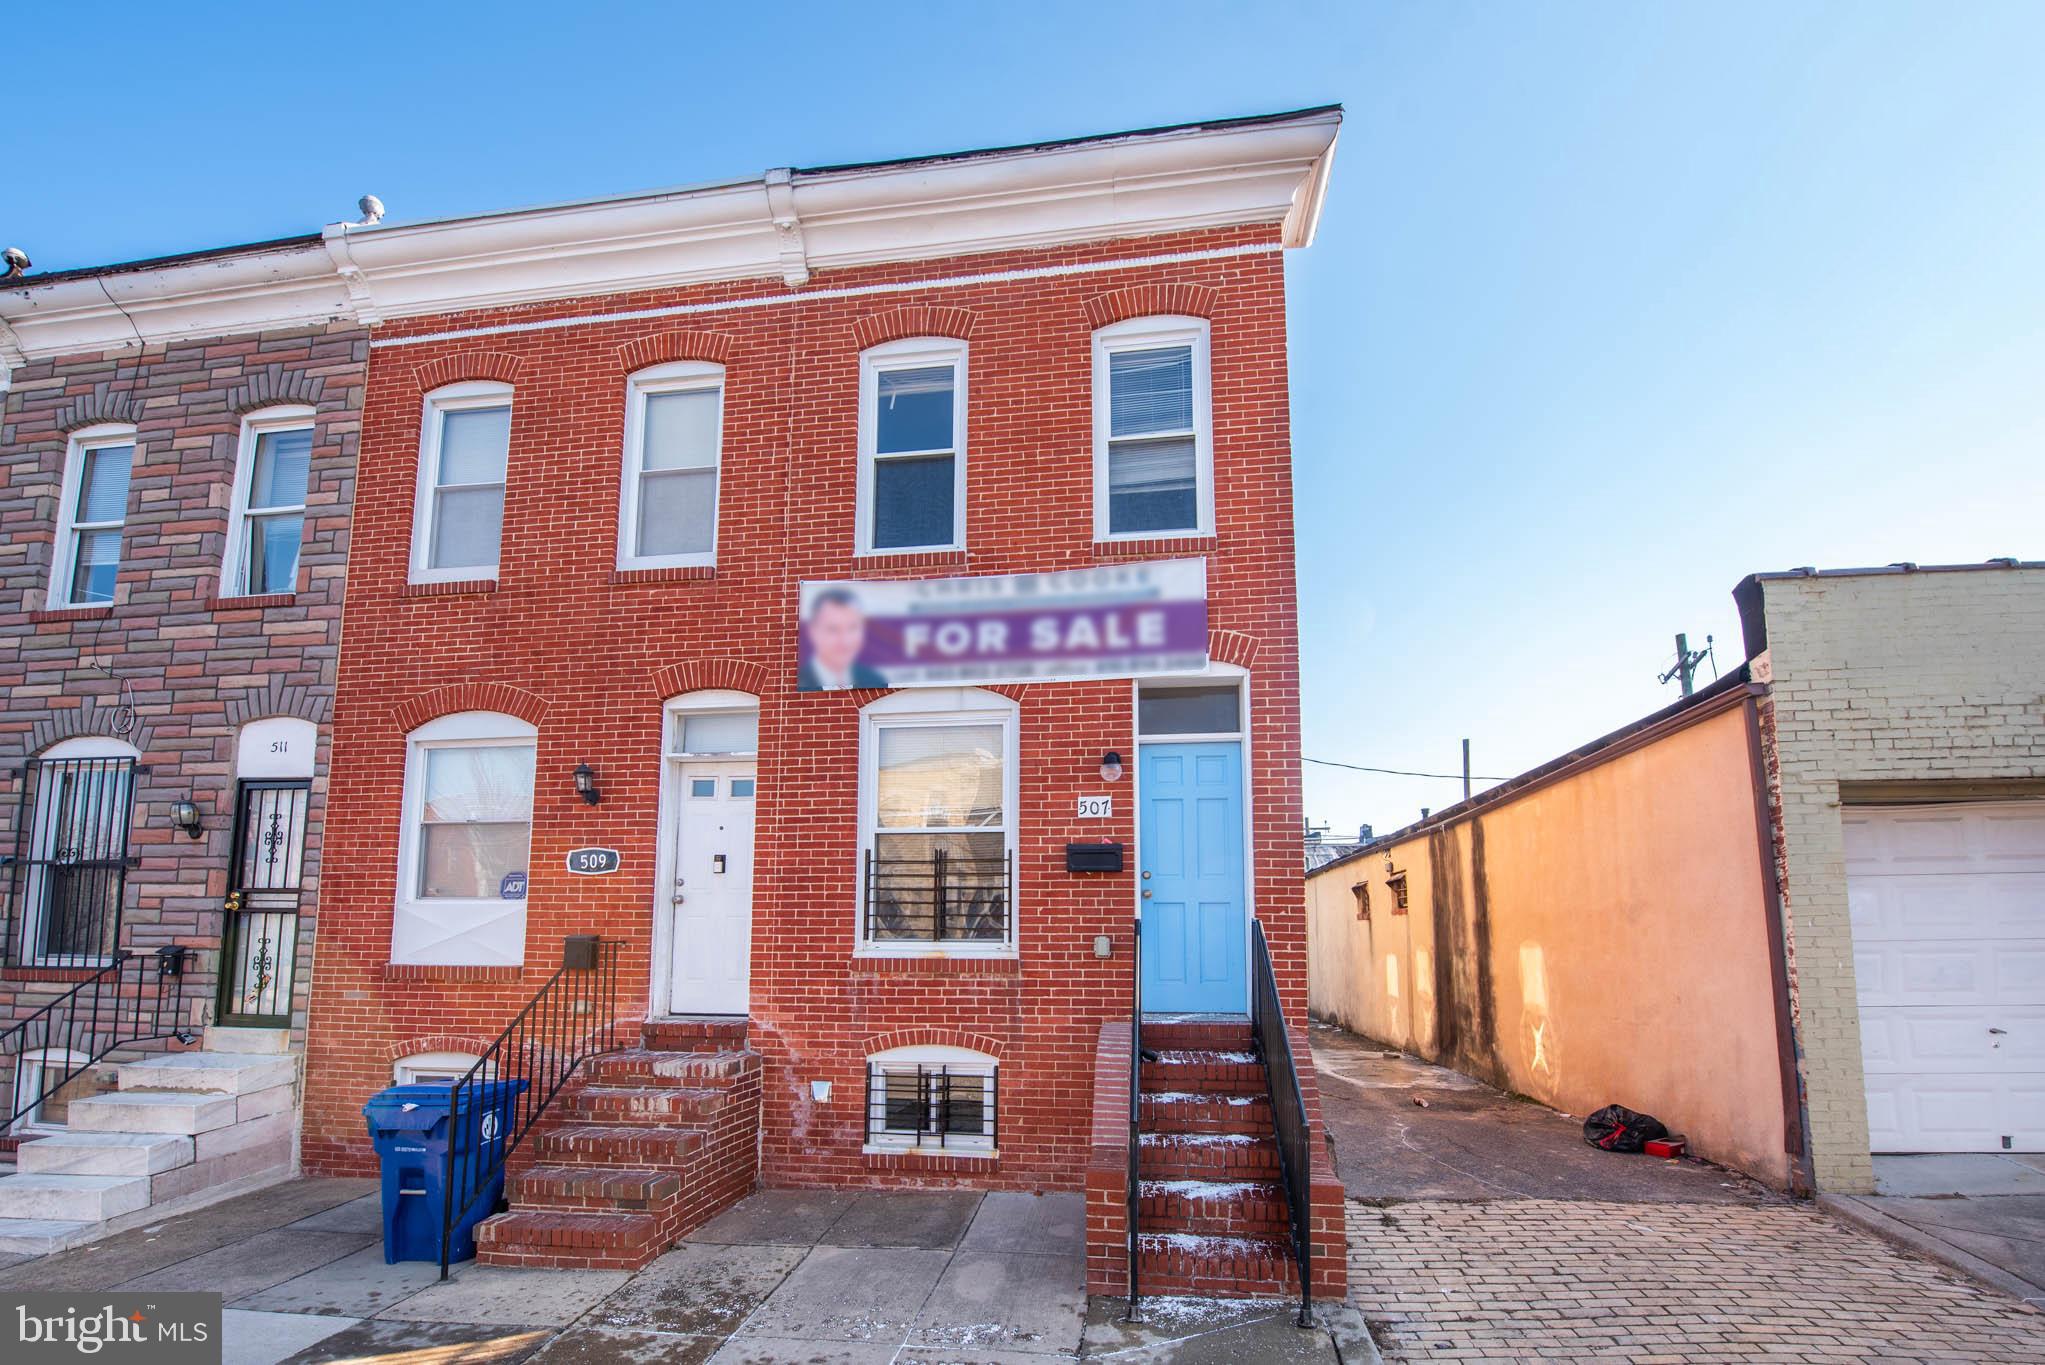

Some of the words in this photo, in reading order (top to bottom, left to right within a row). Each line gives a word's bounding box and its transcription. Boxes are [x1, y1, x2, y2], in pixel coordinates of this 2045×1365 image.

[904, 621, 1009, 658] FOR
[1030, 612, 1165, 650] SALE
[271, 741, 288, 753] 511
[1079, 799, 1110, 815] 507
[580, 853, 607, 869] 509
[504, 881, 525, 893] ADT
